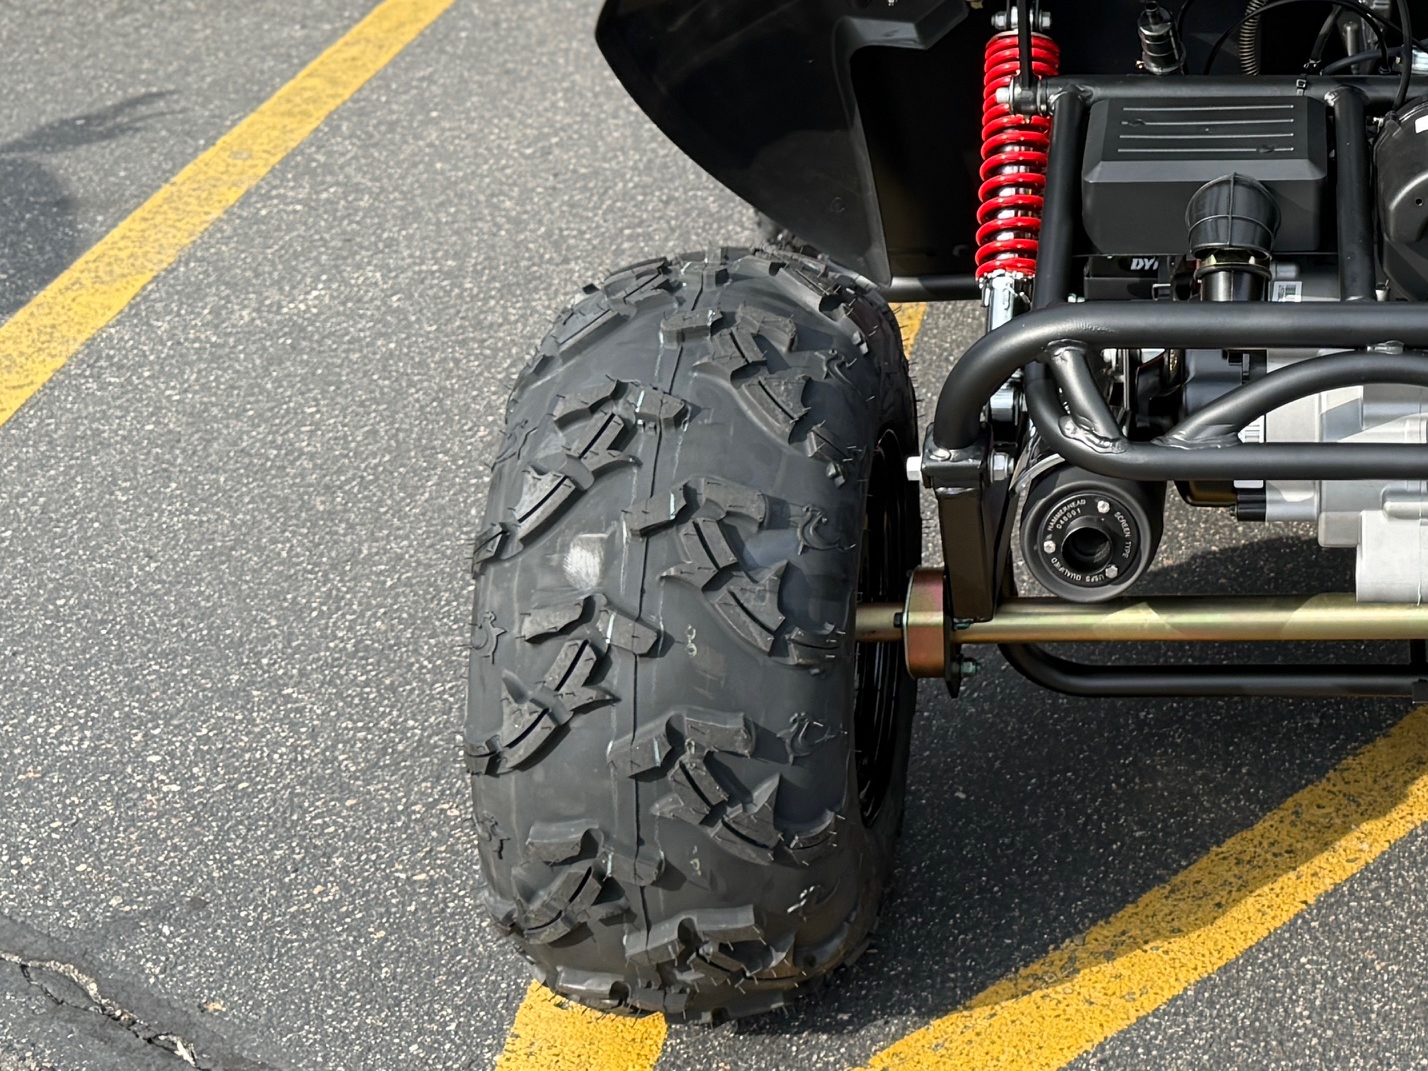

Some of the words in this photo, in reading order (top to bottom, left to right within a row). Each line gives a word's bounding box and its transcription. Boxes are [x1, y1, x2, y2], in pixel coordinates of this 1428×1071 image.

[1047, 498, 1086, 532] HAMMERHEAD
[1113, 510, 1131, 538] SCREEN
[1122, 541, 1132, 559] TYPE
[1050, 557, 1082, 582] QUALIFIED
